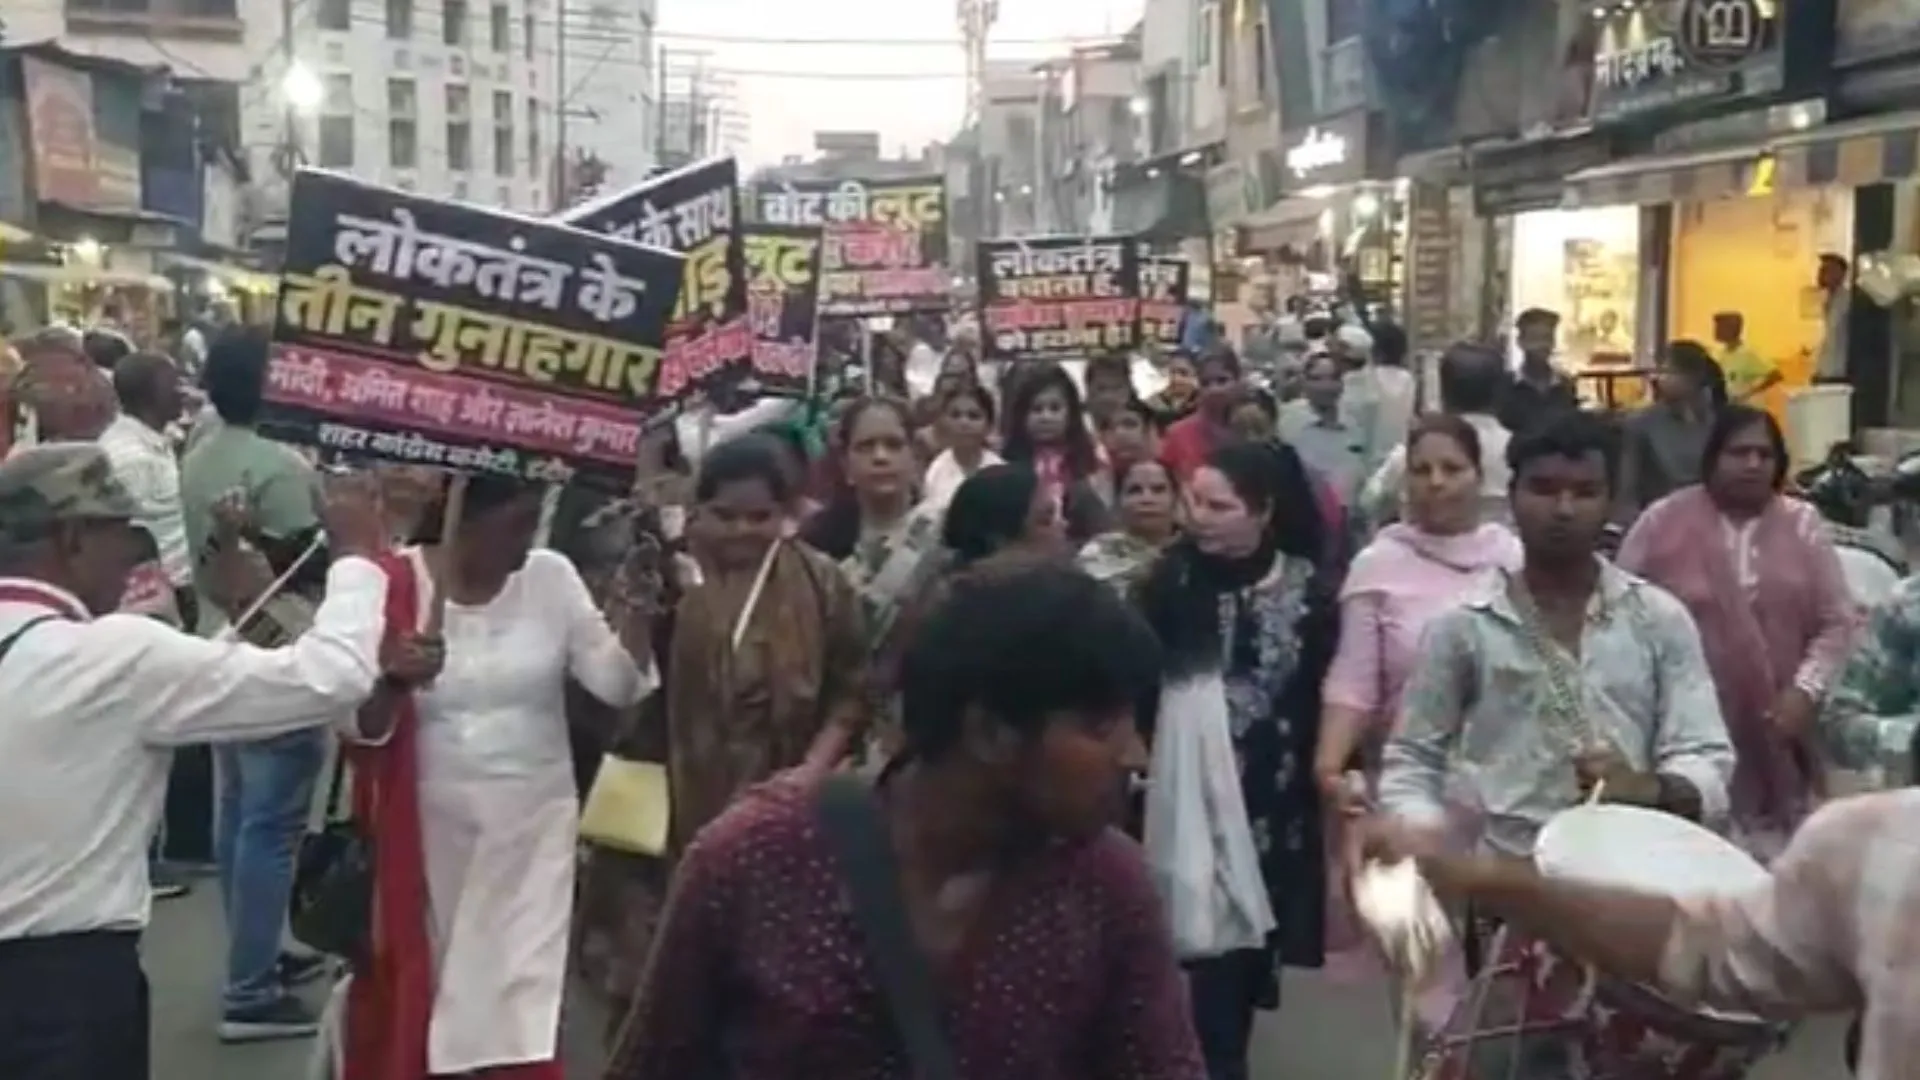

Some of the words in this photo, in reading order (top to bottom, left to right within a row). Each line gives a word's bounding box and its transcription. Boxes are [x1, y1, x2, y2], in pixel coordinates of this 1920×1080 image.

[639, 198, 672, 249] के
[673, 184, 732, 248] साथ
[827, 180, 869, 222] की
[871, 186, 942, 231] लूट
[334, 208, 574, 309] लोकतंत्र
[576, 252, 647, 322] के
[992, 238, 1122, 277] लोकतंत्र
[281, 264, 403, 344] तीन
[411, 297, 664, 396] गुनाहगार
[460, 384, 504, 428] और
[319, 423, 370, 448] शहर
